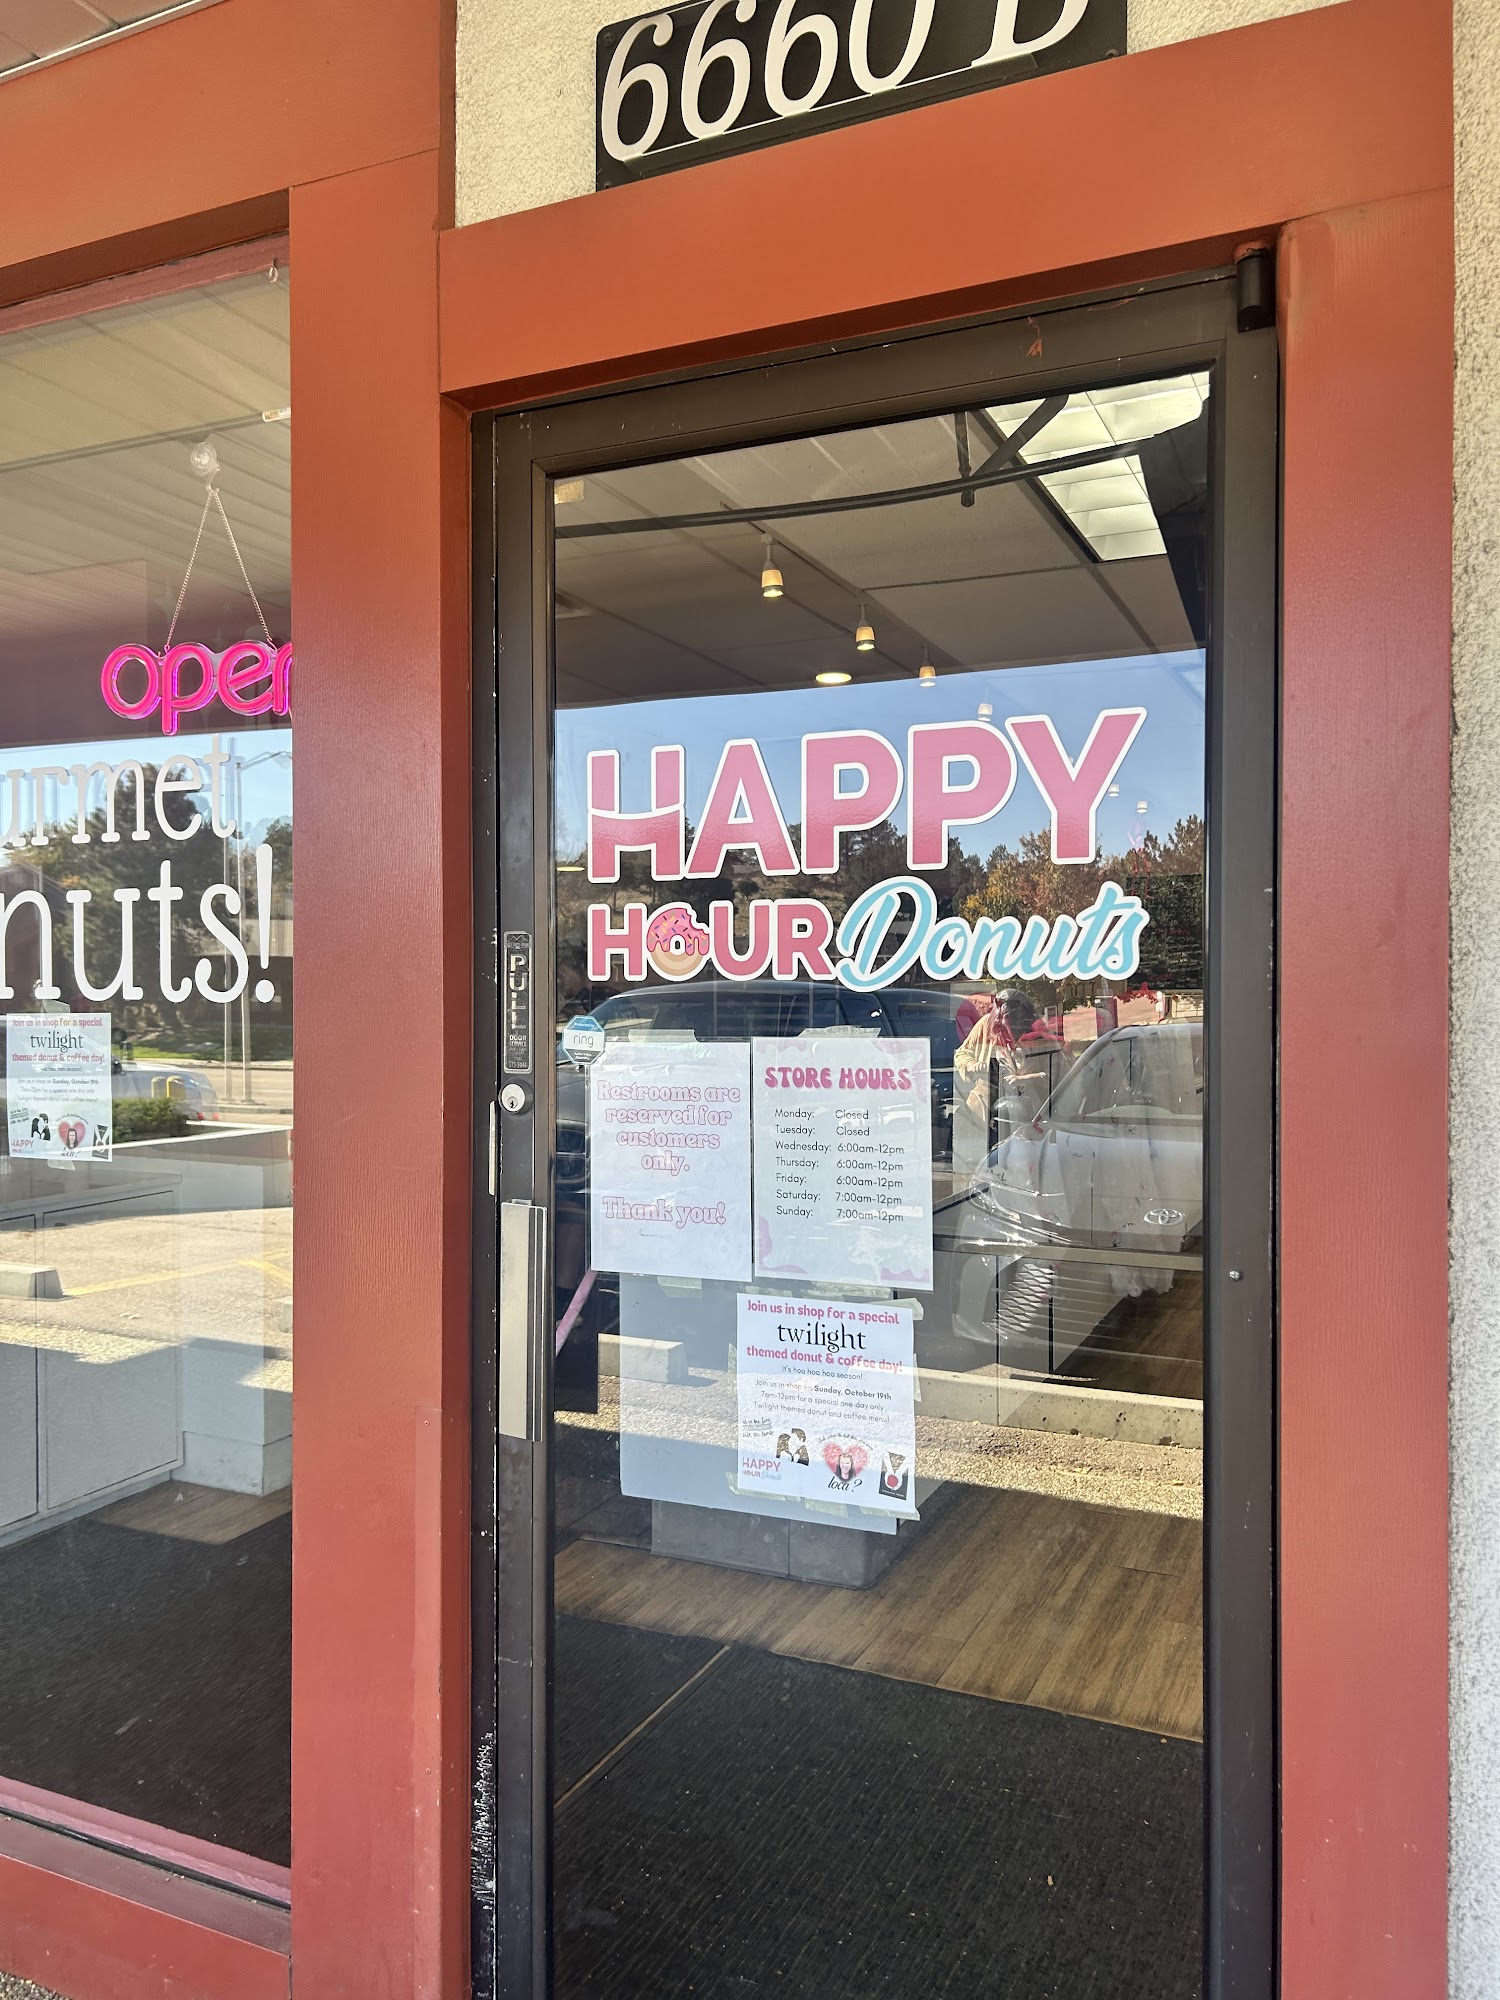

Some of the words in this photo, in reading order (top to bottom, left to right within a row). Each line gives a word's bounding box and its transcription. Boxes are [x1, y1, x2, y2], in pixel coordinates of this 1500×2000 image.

[601, 0, 935, 162] 6660
[587, 706, 1148, 883] HAPPY
[587, 898, 838, 982] HOUR
[835, 876, 1150, 993] Donuts
[509, 954, 527, 1030] PULL
[42, 1018, 59, 1028] shop
[60, 1018, 71, 1026] for
[79, 1017, 103, 1028] special
[30, 1029, 84, 1053] twilight
[573, 1033, 594, 1048] ring
[66, 1053, 90, 1062] coffee
[764, 1066, 833, 1089] STORE
[838, 1067, 913, 1090] HOURS
[596, 1080, 702, 1102] Restrooms
[704, 1086, 741, 1103] are
[605, 1104, 696, 1125] reserved
[697, 1104, 732, 1126] for
[774, 1108, 815, 1121] Monday:
[834, 1109, 869, 1120] Closed
[616, 1128, 720, 1149] customers
[774, 1124, 816, 1137] Tuesday:
[836, 1126, 870, 1136] Closed
[775, 1141, 832, 1154] Wednesday:
[837, 1142, 905, 1156] 6:00am-12pm
[641, 1150, 690, 1176] only.
[775, 1156, 819, 1170] Thursday:
[836, 1159, 904, 1172] 6:00am-12pm
[776, 1173, 807, 1186] Friday:
[836, 1176, 903, 1189] 6:00am-12pm
[776, 1189, 821, 1202] Saturday:
[835, 1192, 902, 1206] 7:00am-12pm
[602, 1196, 674, 1222] Thank
[676, 1202, 727, 1229] you!
[776, 1206, 813, 1219] Sunday:
[836, 1208, 904, 1223] 7:00am-12pm
[747, 1300, 768, 1312] Join
[770, 1304, 782, 1314] us
[786, 1302, 795, 1315] in
[797, 1304, 825, 1320] shop
[827, 1306, 846, 1320] for
[849, 1310, 856, 1320] a
[858, 1310, 900, 1324] special
[776, 1322, 867, 1354] twilight
[746, 1345, 788, 1360] themed
[790, 1349, 823, 1364] donut
[825, 1352, 834, 1364] &
[838, 1354, 876, 1369] coffee
[878, 1358, 903, 1375] day!
[836, 1371, 863, 1380] season!
[755, 1378, 769, 1387] Join
[814, 1384, 844, 1396] Sunday,
[844, 1388, 876, 1398] October
[876, 1391, 892, 1401] 19th
[761, 1390, 796, 1402] 7am-12pm
[797, 1395, 807, 1403] for
[814, 1397, 839, 1407] special
[854, 1400, 869, 1410] day
[780, 1403, 806, 1414] themed
[843, 1410, 867, 1421] coffee
[742, 1457, 781, 1472] HAPPY
